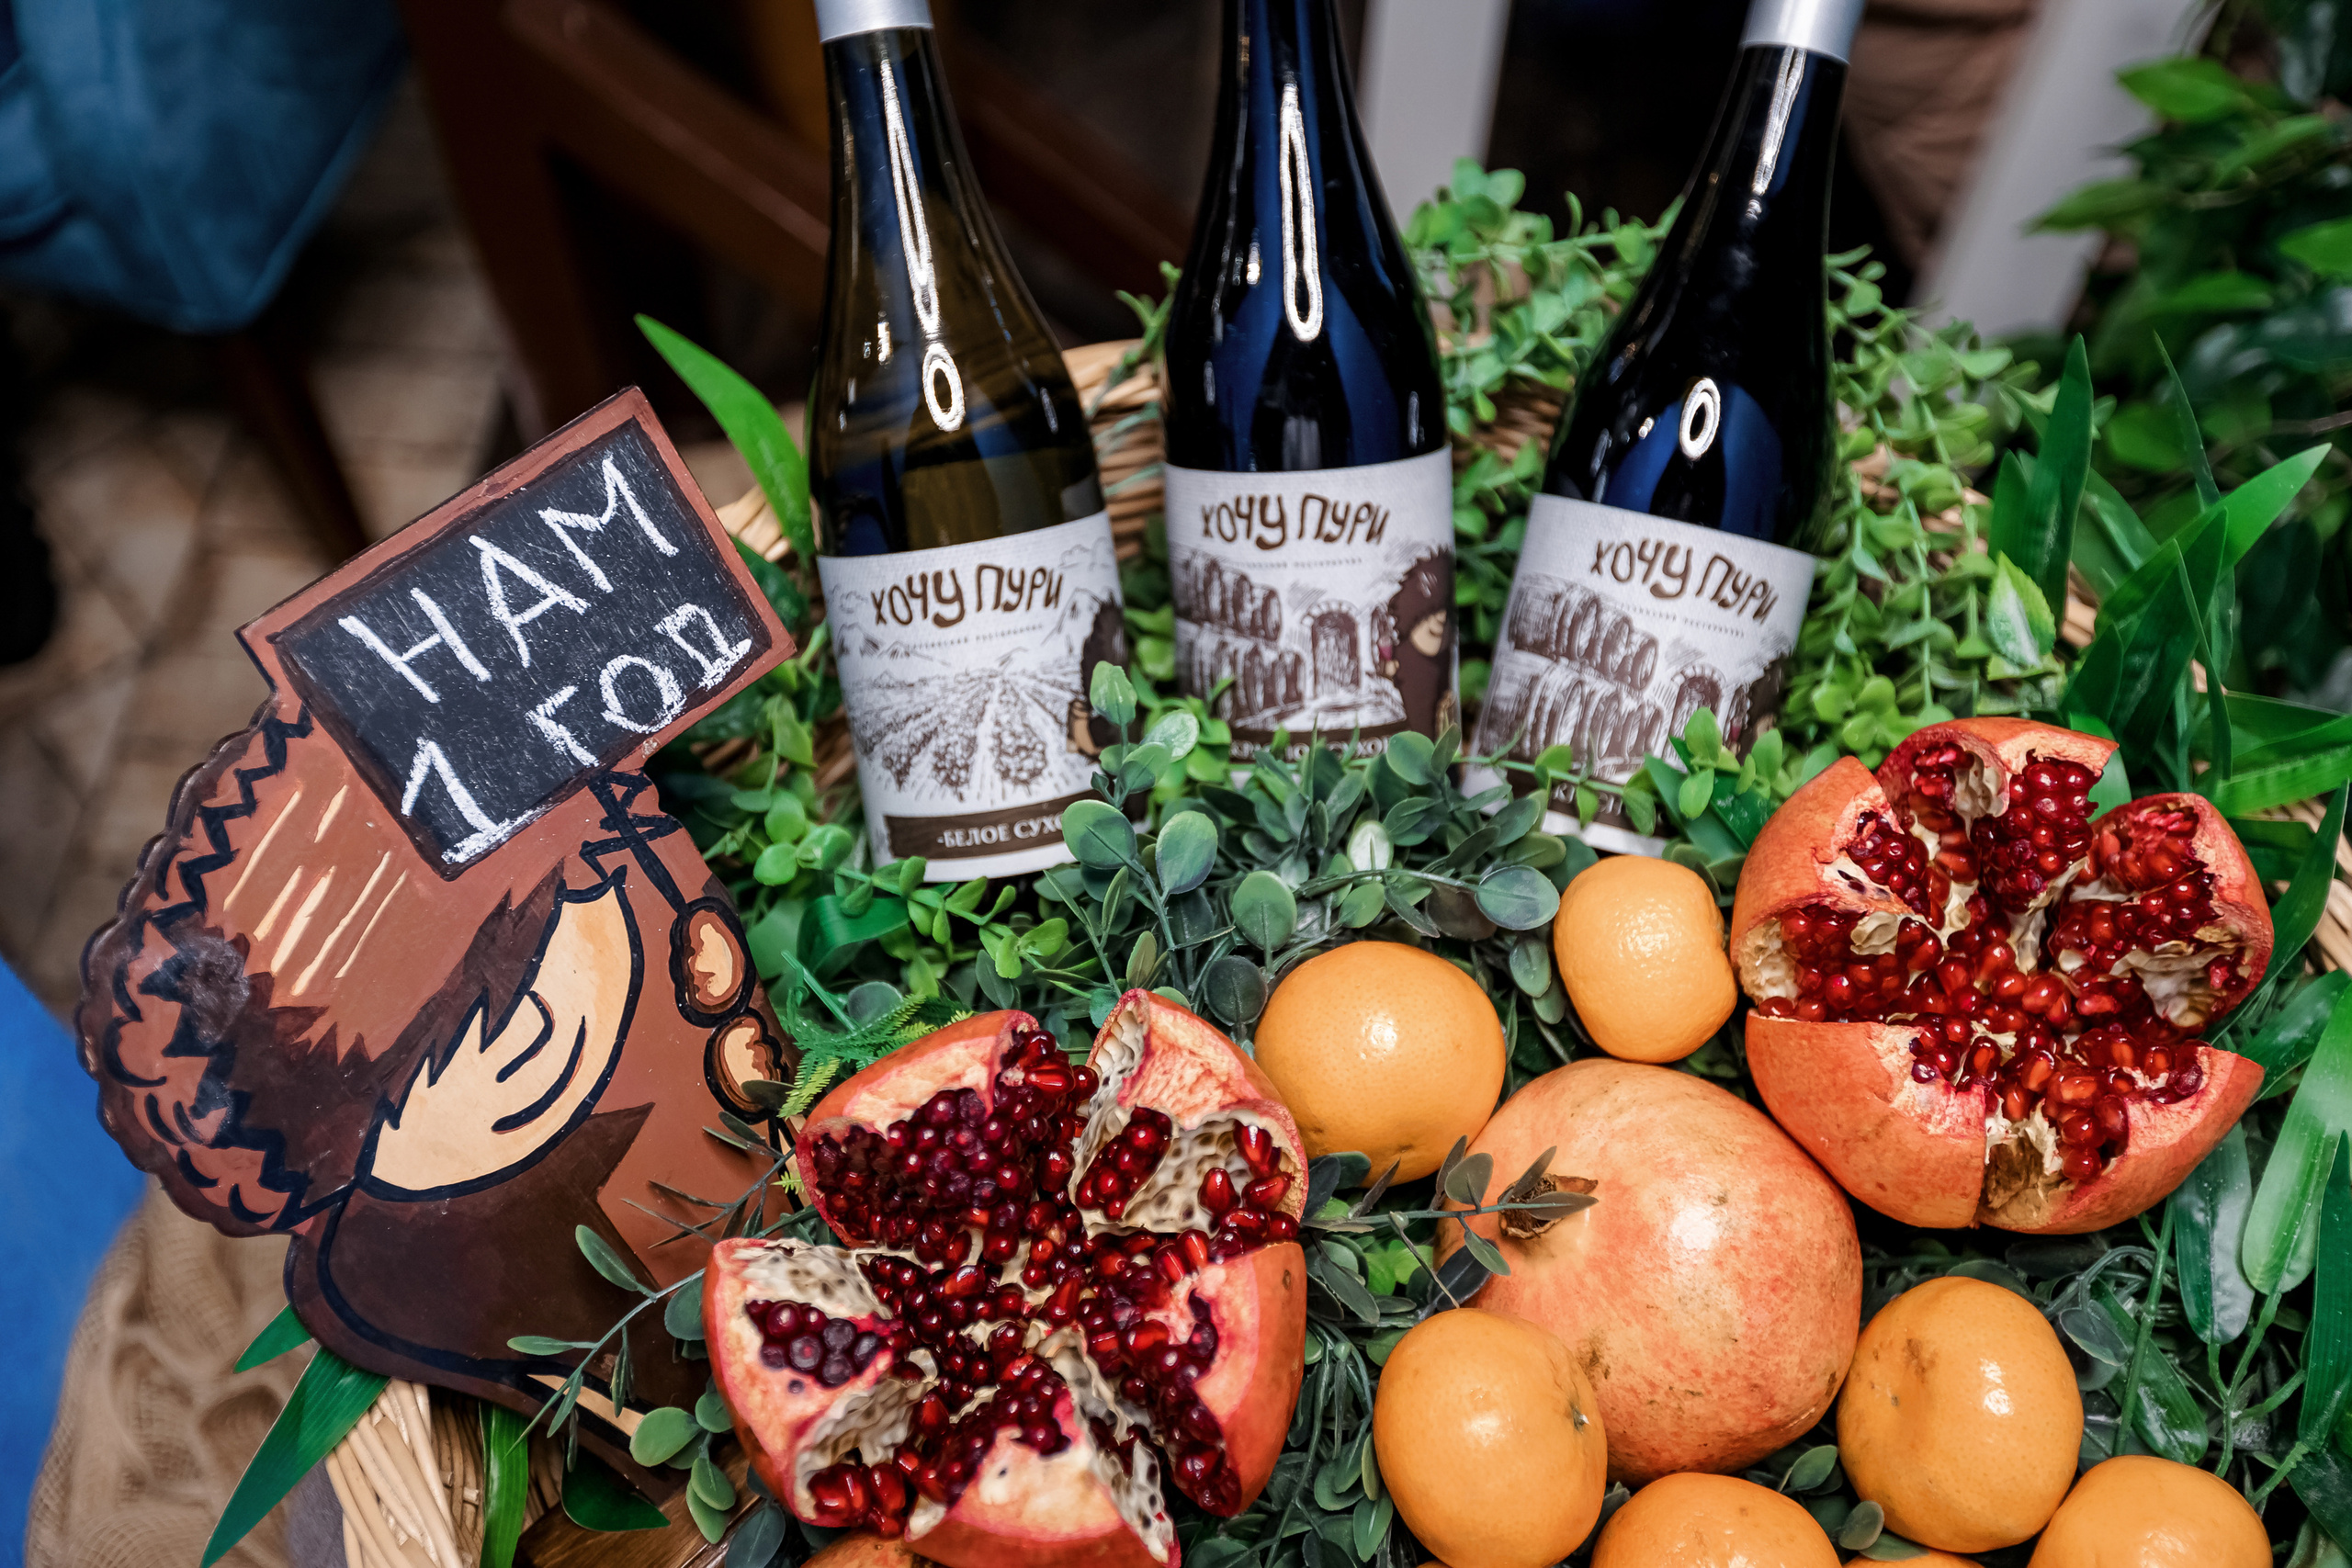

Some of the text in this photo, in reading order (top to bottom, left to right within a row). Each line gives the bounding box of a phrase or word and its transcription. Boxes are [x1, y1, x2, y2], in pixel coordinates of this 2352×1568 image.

[1201, 492, 1390, 551] ХОЧУ ПУРИ
[337, 454, 680, 704] НАМ
[870, 563, 1063, 628] ХОЧУ ПУРИ
[1589, 537, 1693, 600] ХОЧУ
[1695, 553, 1780, 625] ПУРИ
[401, 602, 752, 864] 1 ГОД
[1013, 812, 1063, 840] СУХО
